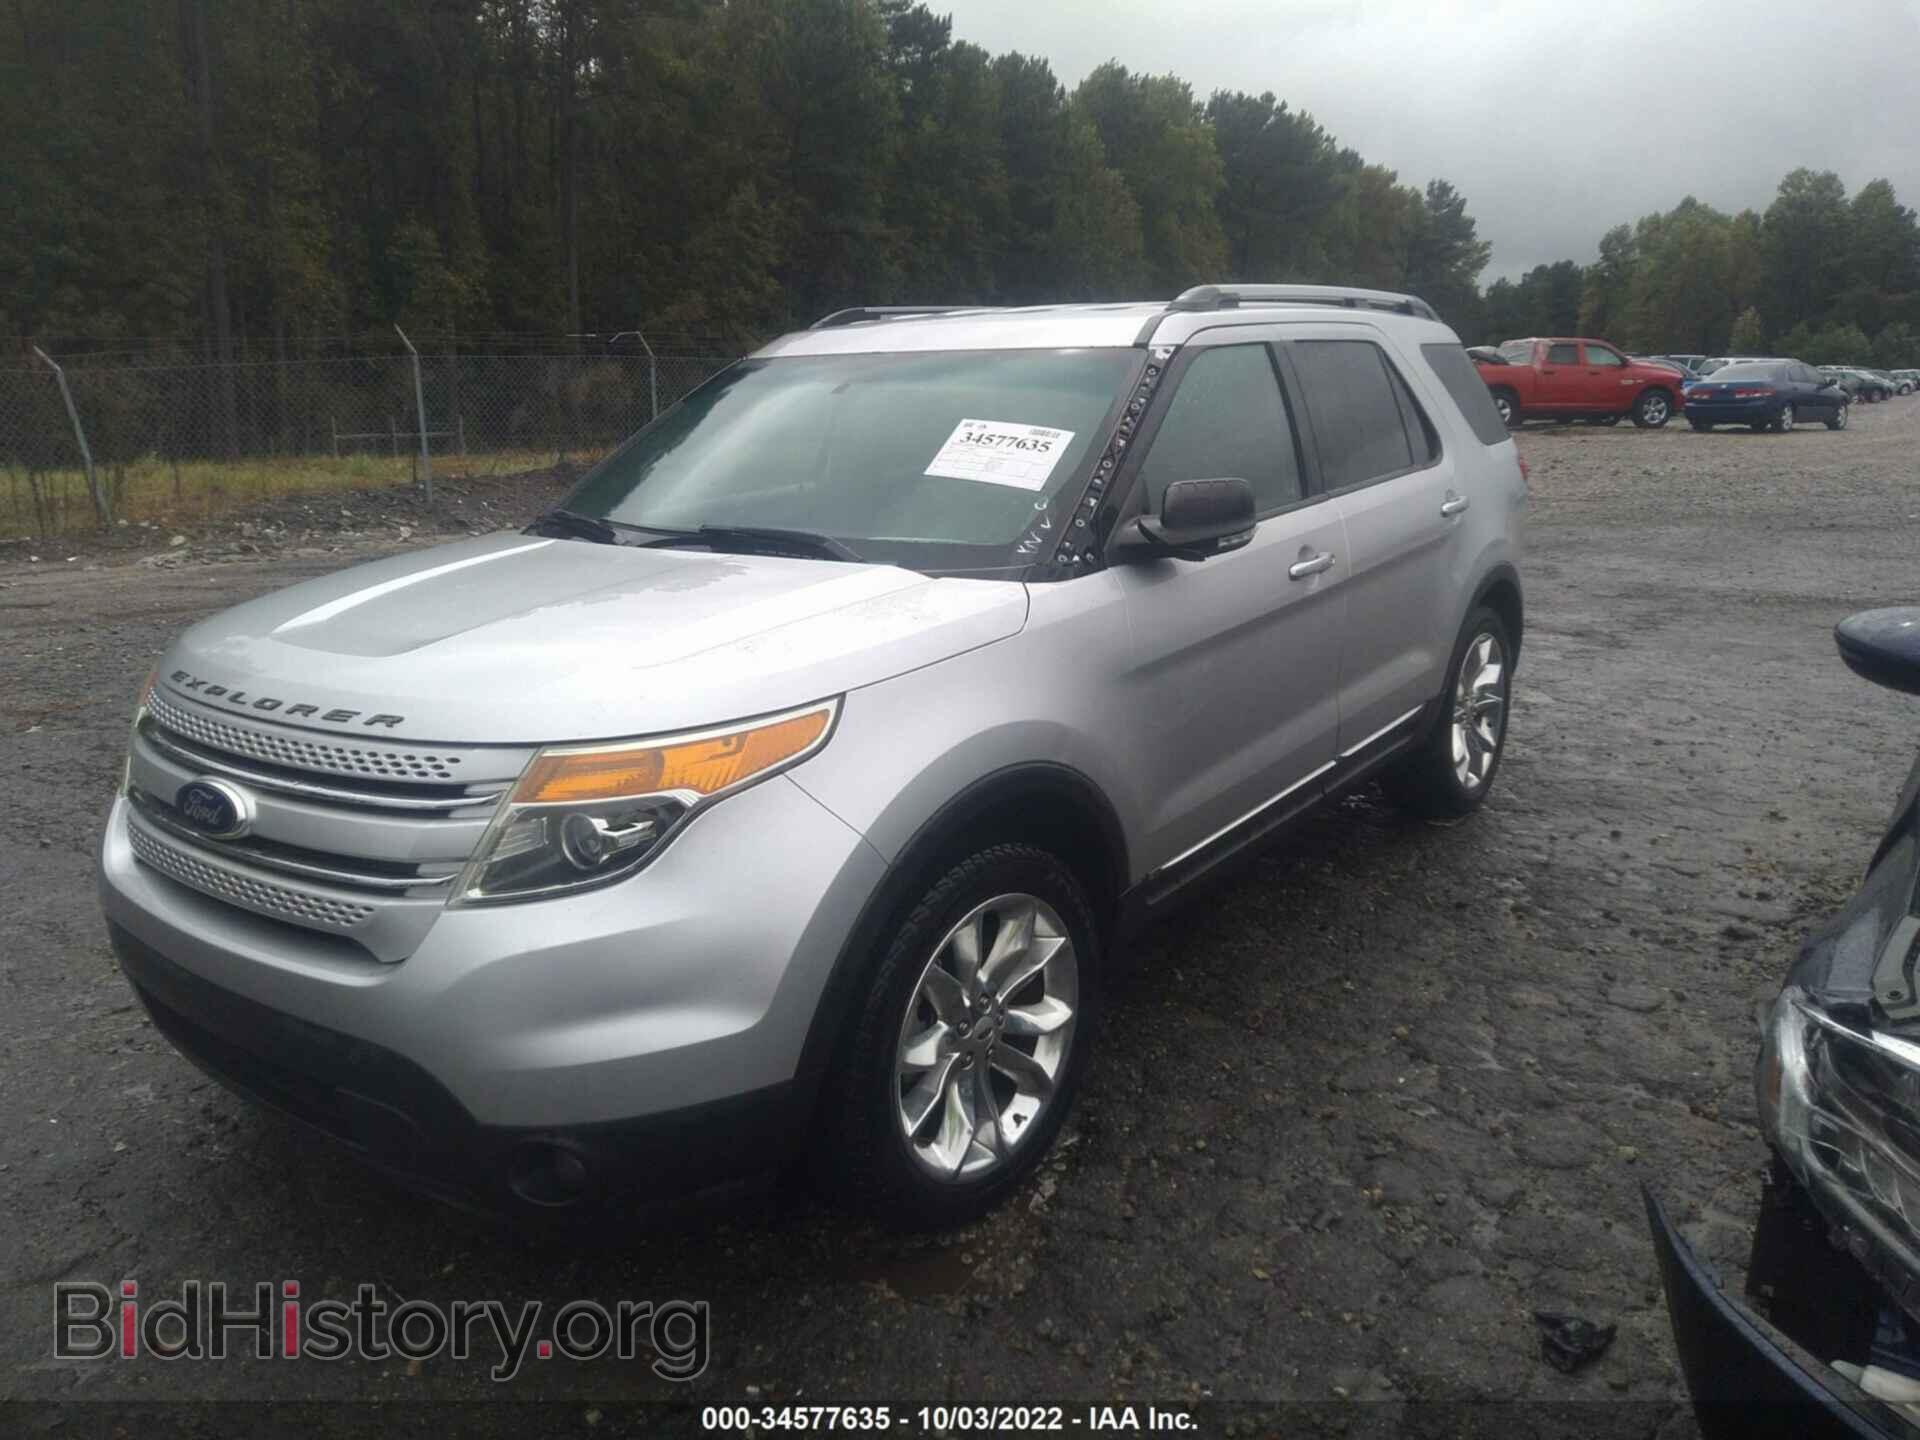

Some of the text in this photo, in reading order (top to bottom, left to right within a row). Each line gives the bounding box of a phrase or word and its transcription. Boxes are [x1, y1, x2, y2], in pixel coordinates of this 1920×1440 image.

[959, 432, 1053, 452] 34577635
[169, 669, 405, 729] EXPLORER
[183, 788, 224, 825] Ford
